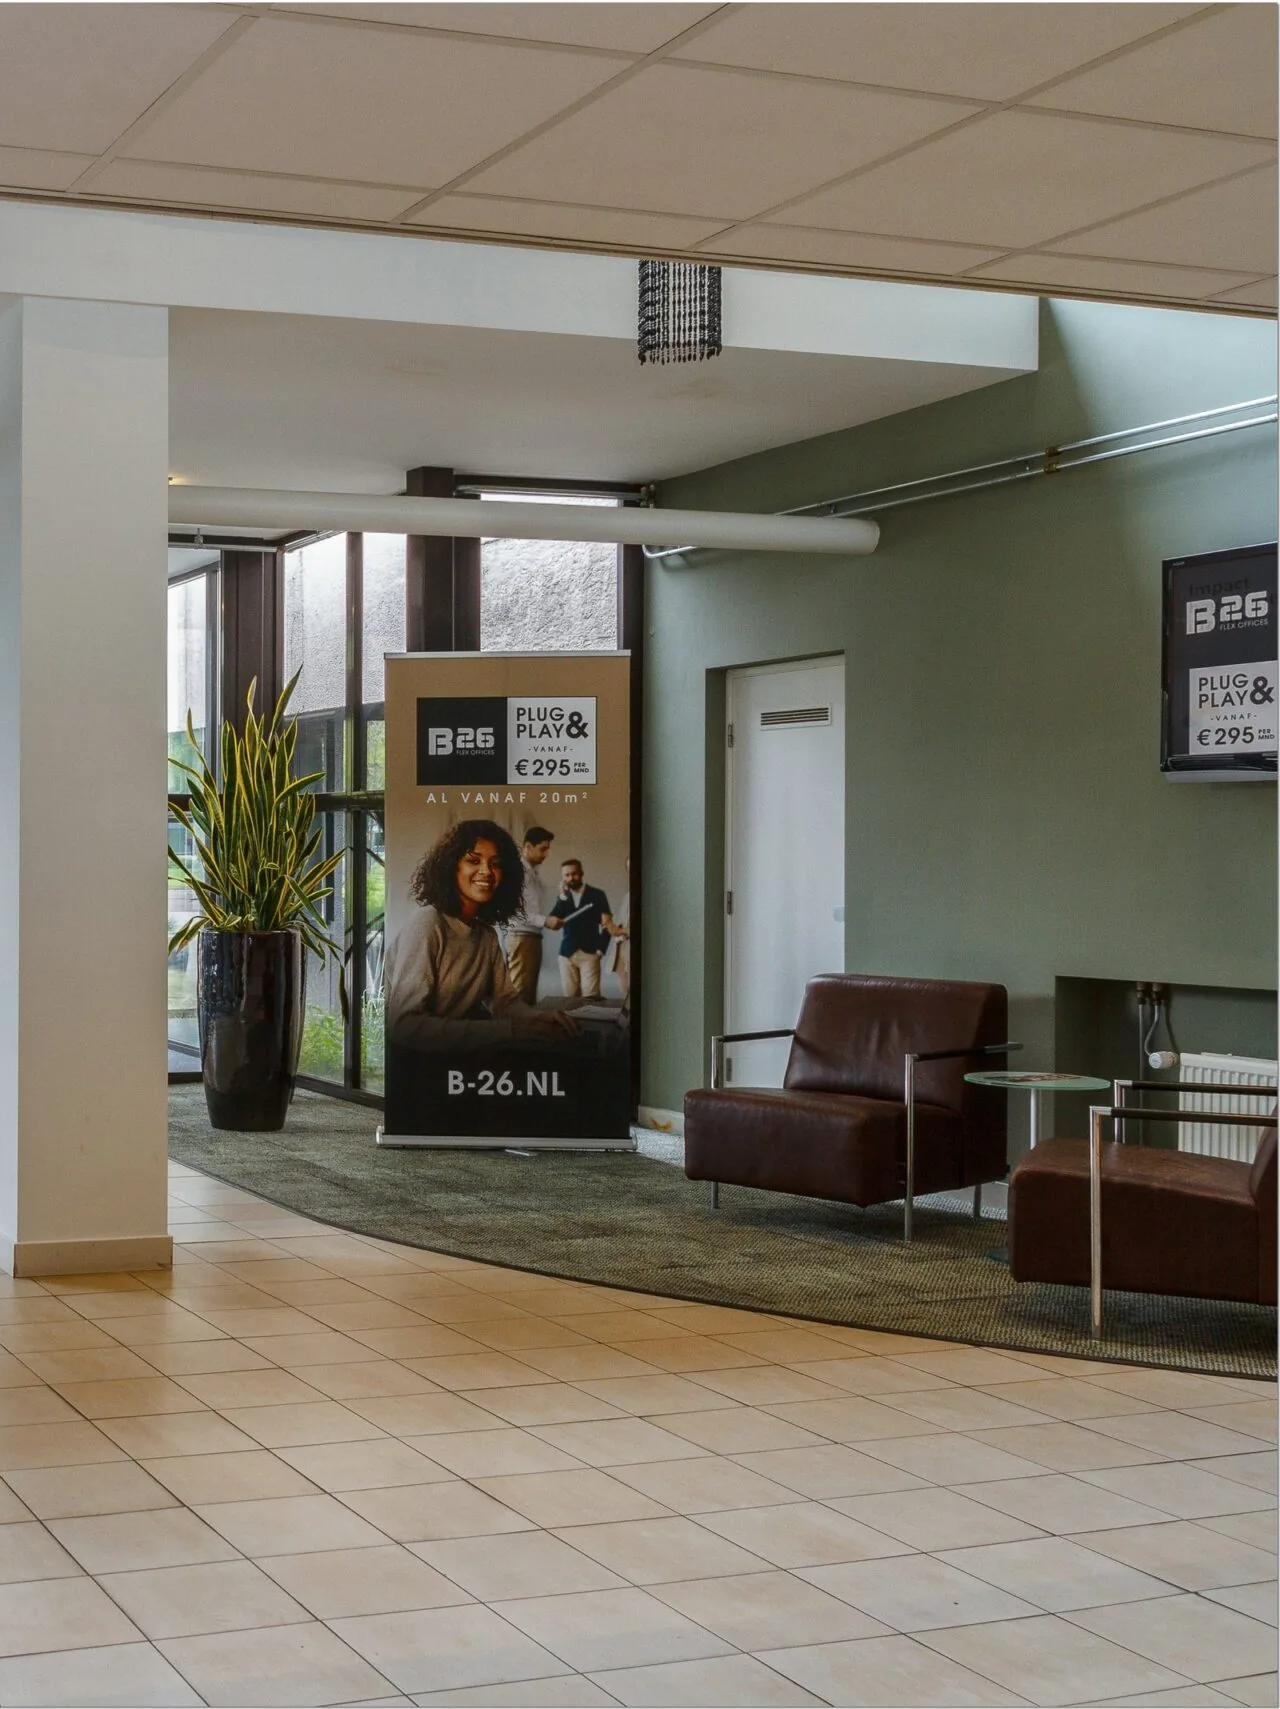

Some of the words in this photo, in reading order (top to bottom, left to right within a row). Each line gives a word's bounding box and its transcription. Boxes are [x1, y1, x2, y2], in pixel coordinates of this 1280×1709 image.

[1220, 622, 1236, 631] FLEX
[1237, 618, 1269, 629] OFFICES
[1199, 673, 1249, 692] PLUG
[1249, 676, 1275, 705] &
[1199, 690, 1249, 709] PLAY
[516, 707, 565, 721] PLUG
[565, 711, 589, 739] &
[516, 723, 564, 739] PLAY
[1196, 726, 1255, 746] €295
[514, 758, 571, 776] €295
[426, 792, 448, 804] AL
[461, 792, 528, 804] VANAF
[447, 1070, 566, 1097] B-26.NL
